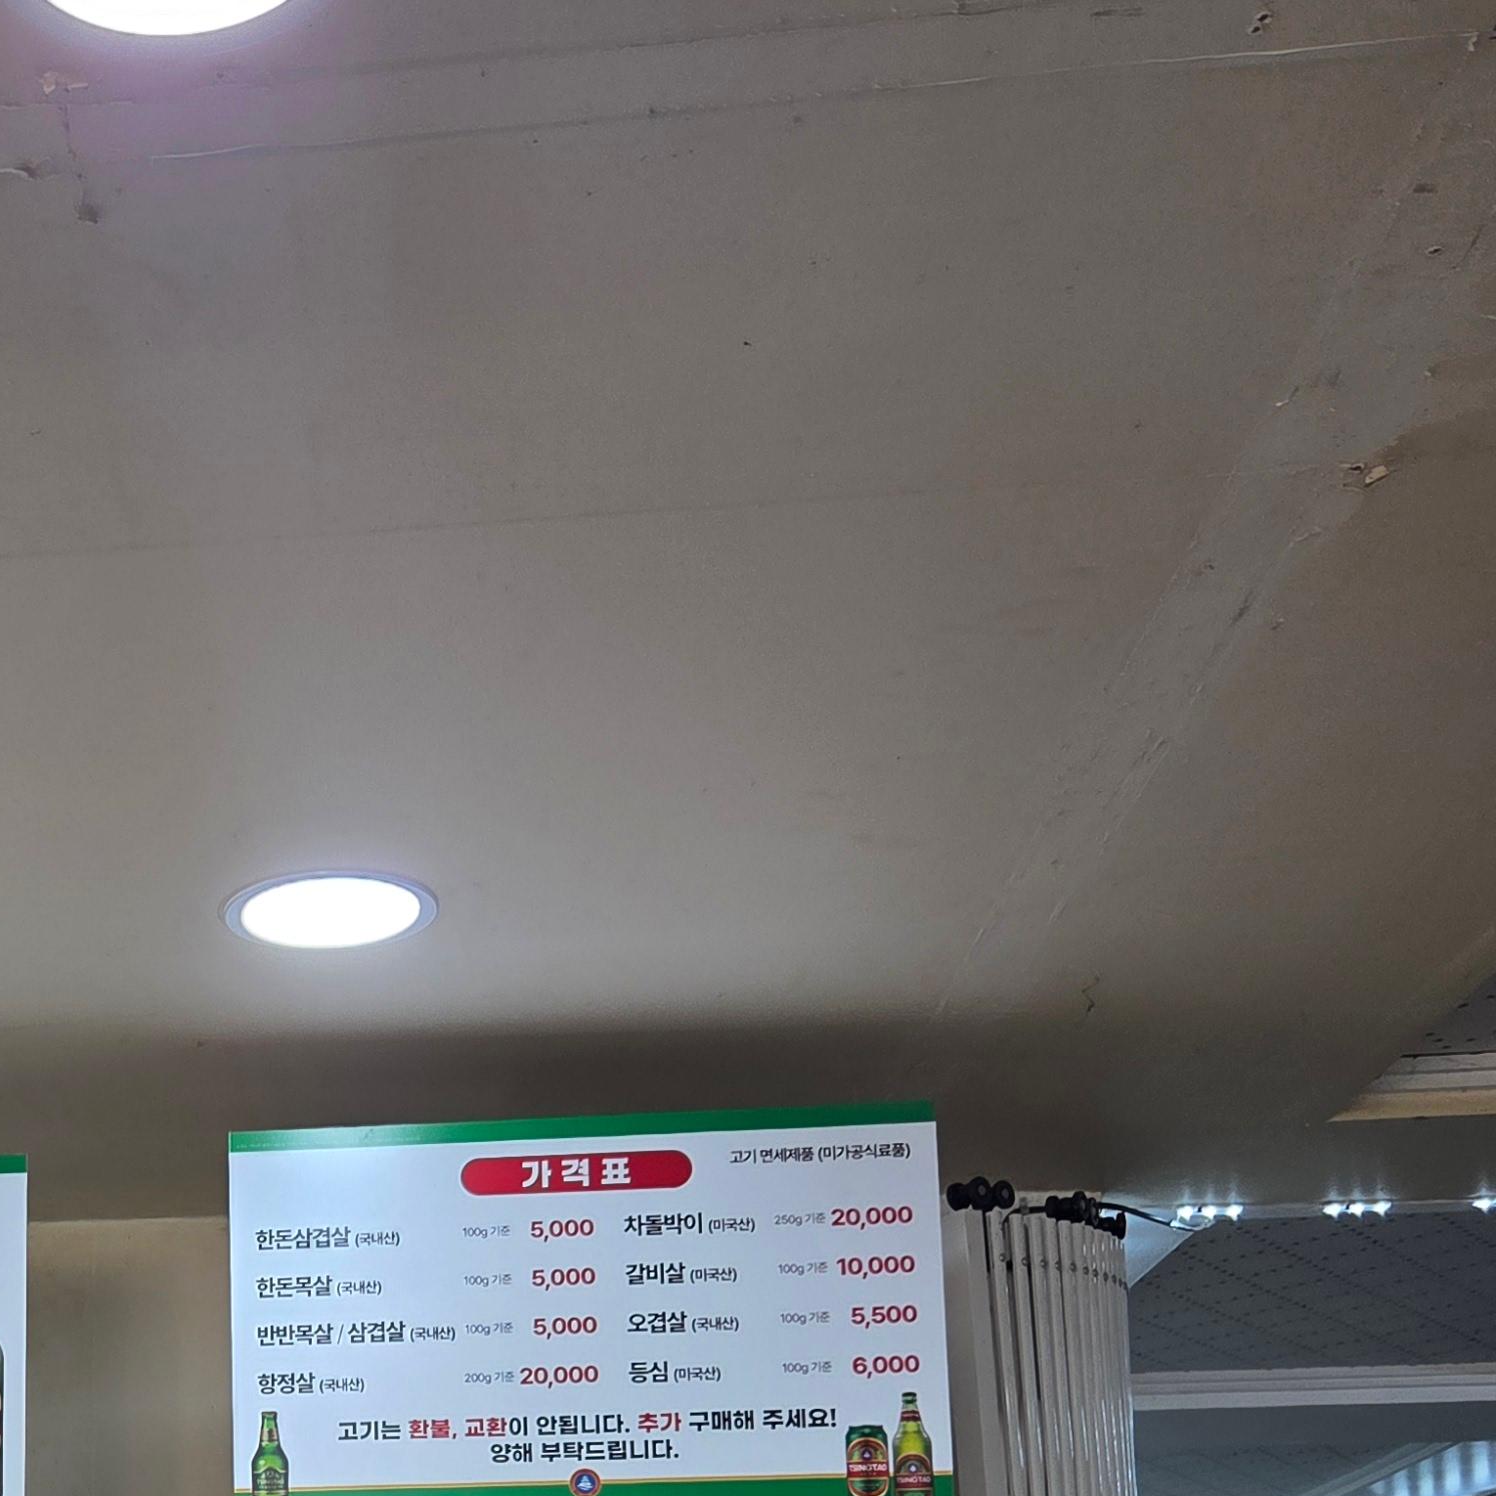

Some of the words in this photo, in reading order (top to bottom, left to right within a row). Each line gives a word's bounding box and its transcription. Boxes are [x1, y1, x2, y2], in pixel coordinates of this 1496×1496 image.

[729, 1150, 756, 1165] 고기
[760, 1147, 814, 1164] 면세제품
[818, 1142, 911, 1162] (미가공식료품)
[521, 1156, 632, 1188] 가격표
[255, 1226, 351, 1250] 한돈삼겹살
[355, 1231, 400, 1248] (국내산)
[462, 1226, 489, 1241] 100g
[490, 1224, 511, 1238] 기준
[529, 1218, 595, 1242] 5,000
[623, 1212, 704, 1236] 차돌박이
[707, 1216, 756, 1234] (미국산)
[773, 1214, 803, 1227] 250g
[804, 1212, 826, 1225] 기준
[830, 1206, 913, 1230] 20,000
[255, 1275, 332, 1299] 한돈목살
[336, 1280, 382, 1297] (국내산)
[463, 1275, 490, 1289] 100g
[491, 1273, 512, 1287] 기준
[531, 1267, 596, 1292] 5,000
[625, 1262, 685, 1286] 갈비살
[689, 1266, 737, 1284] (미국산)
[777, 1263, 805, 1276] 100g
[807, 1261, 828, 1275] 기준
[836, 1255, 916, 1280] 10,000
[257, 1323, 334, 1348] 반반목살
[347, 1321, 406, 1344] 삼겹살
[410, 1325, 456, 1343] (국내산)
[464, 1323, 492, 1337] 100g
[493, 1321, 514, 1335] 기준
[533, 1316, 597, 1341] 5,000
[627, 1311, 687, 1334] 오겹살
[691, 1315, 739, 1333] (국내산)
[780, 1312, 807, 1326] 100g
[808, 1310, 830, 1324] 기준
[850, 1304, 918, 1329] 5,500
[257, 1372, 316, 1395] 항정살
[319, 1376, 365, 1394] (국내산)
[464, 1372, 493, 1386] 200g
[494, 1370, 515, 1384] 기준
[519, 1365, 599, 1390] 20,000
[628, 1361, 669, 1383] 등심
[674, 1366, 721, 1384] (미국산)
[782, 1361, 809, 1375] 100g
[811, 1359, 832, 1373] 기준
[852, 1354, 920, 1380] 6,000
[337, 1421, 401, 1441] 고기는
[408, 1419, 458, 1441] 환불,
[464, 1416, 529, 1438] 교환이
[536, 1414, 631, 1437] 안됩니다.
[637, 1412, 682, 1434] 추가
[689, 1409, 755, 1431] 구매해
[762, 1407, 838, 1430] 주세요!
[490, 1442, 533, 1463] 양해
[540, 1439, 679, 1462] 부탁드립니다.
